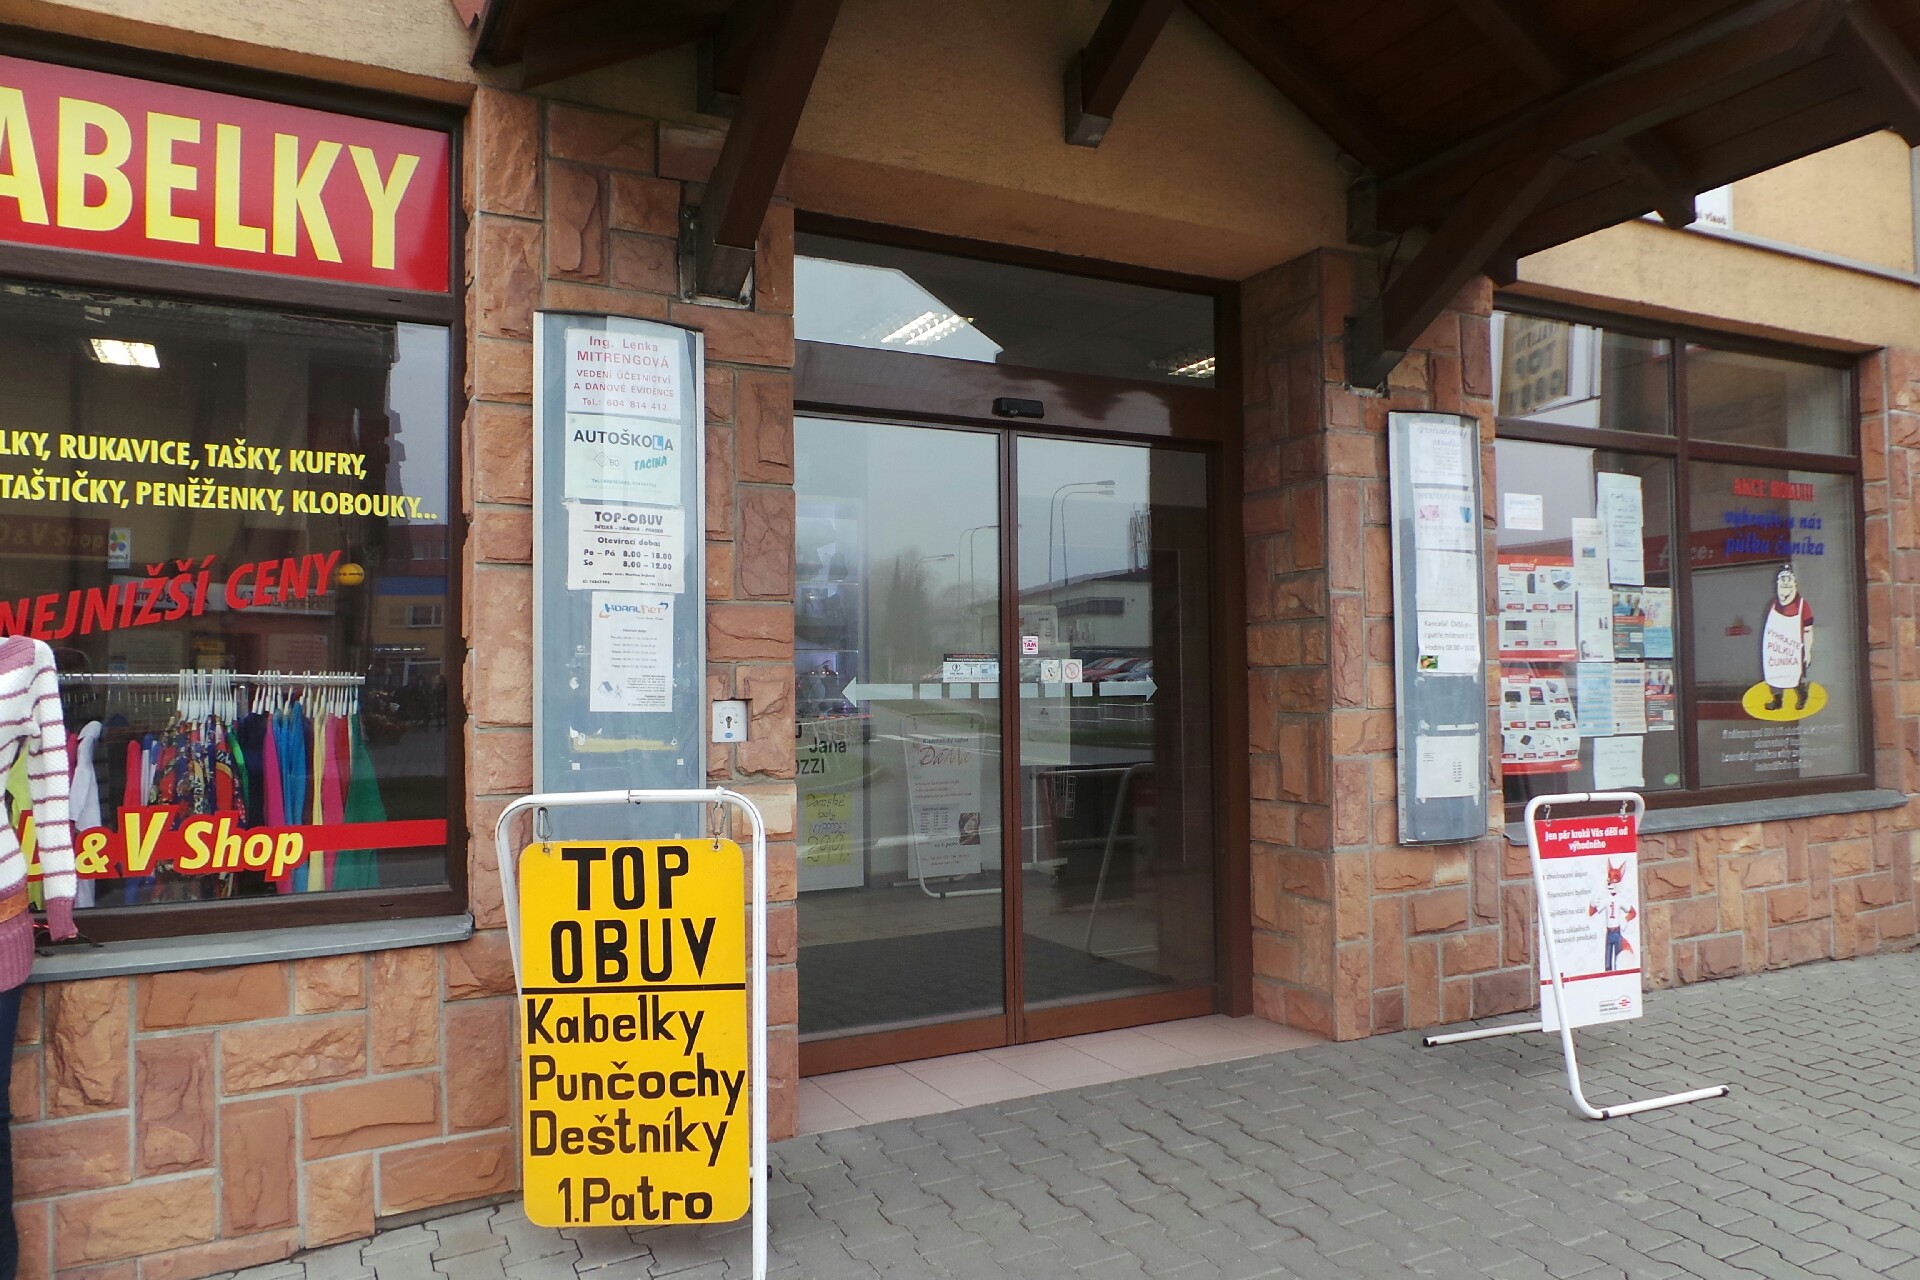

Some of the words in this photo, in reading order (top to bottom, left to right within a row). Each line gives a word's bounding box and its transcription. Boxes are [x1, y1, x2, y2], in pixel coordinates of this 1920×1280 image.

[577, 350, 669, 368] MITRENGOVÁ
[589, 336, 614, 349] Ing.
[622, 338, 658, 352] Lenka
[576, 370, 612, 378] VEDENÍ
[630, 400, 646, 408] 814
[651, 402, 667, 410] 412
[631, 386, 674, 397] EVIDENCE
[573, 428, 674, 450] AUTOŠKOLA
[60, 434, 199, 470] RUKAVICE,
[205, 438, 282, 475] TAŠKY,
[289, 448, 367, 480] KUFRY,
[136, 477, 285, 516] PENĚŽENKY,
[292, 489, 438, 520] KLOBOUKY...
[224, 550, 342, 611] CENY
[809, 737, 847, 754] Jana
[796, 758, 825, 774] ZZI
[124, 812, 169, 871] V
[179, 818, 304, 876] Shop
[1545, 832, 1558, 842] Jen
[1558, 830, 1570, 842] pár
[1619, 826, 1628, 836] od
[562, 846, 688, 910] TOP
[550, 917, 716, 984] OBUV
[526, 994, 704, 1056] Kabelky
[528, 1052, 746, 1116] Punčochy
[530, 1107, 728, 1167] Deštníky
